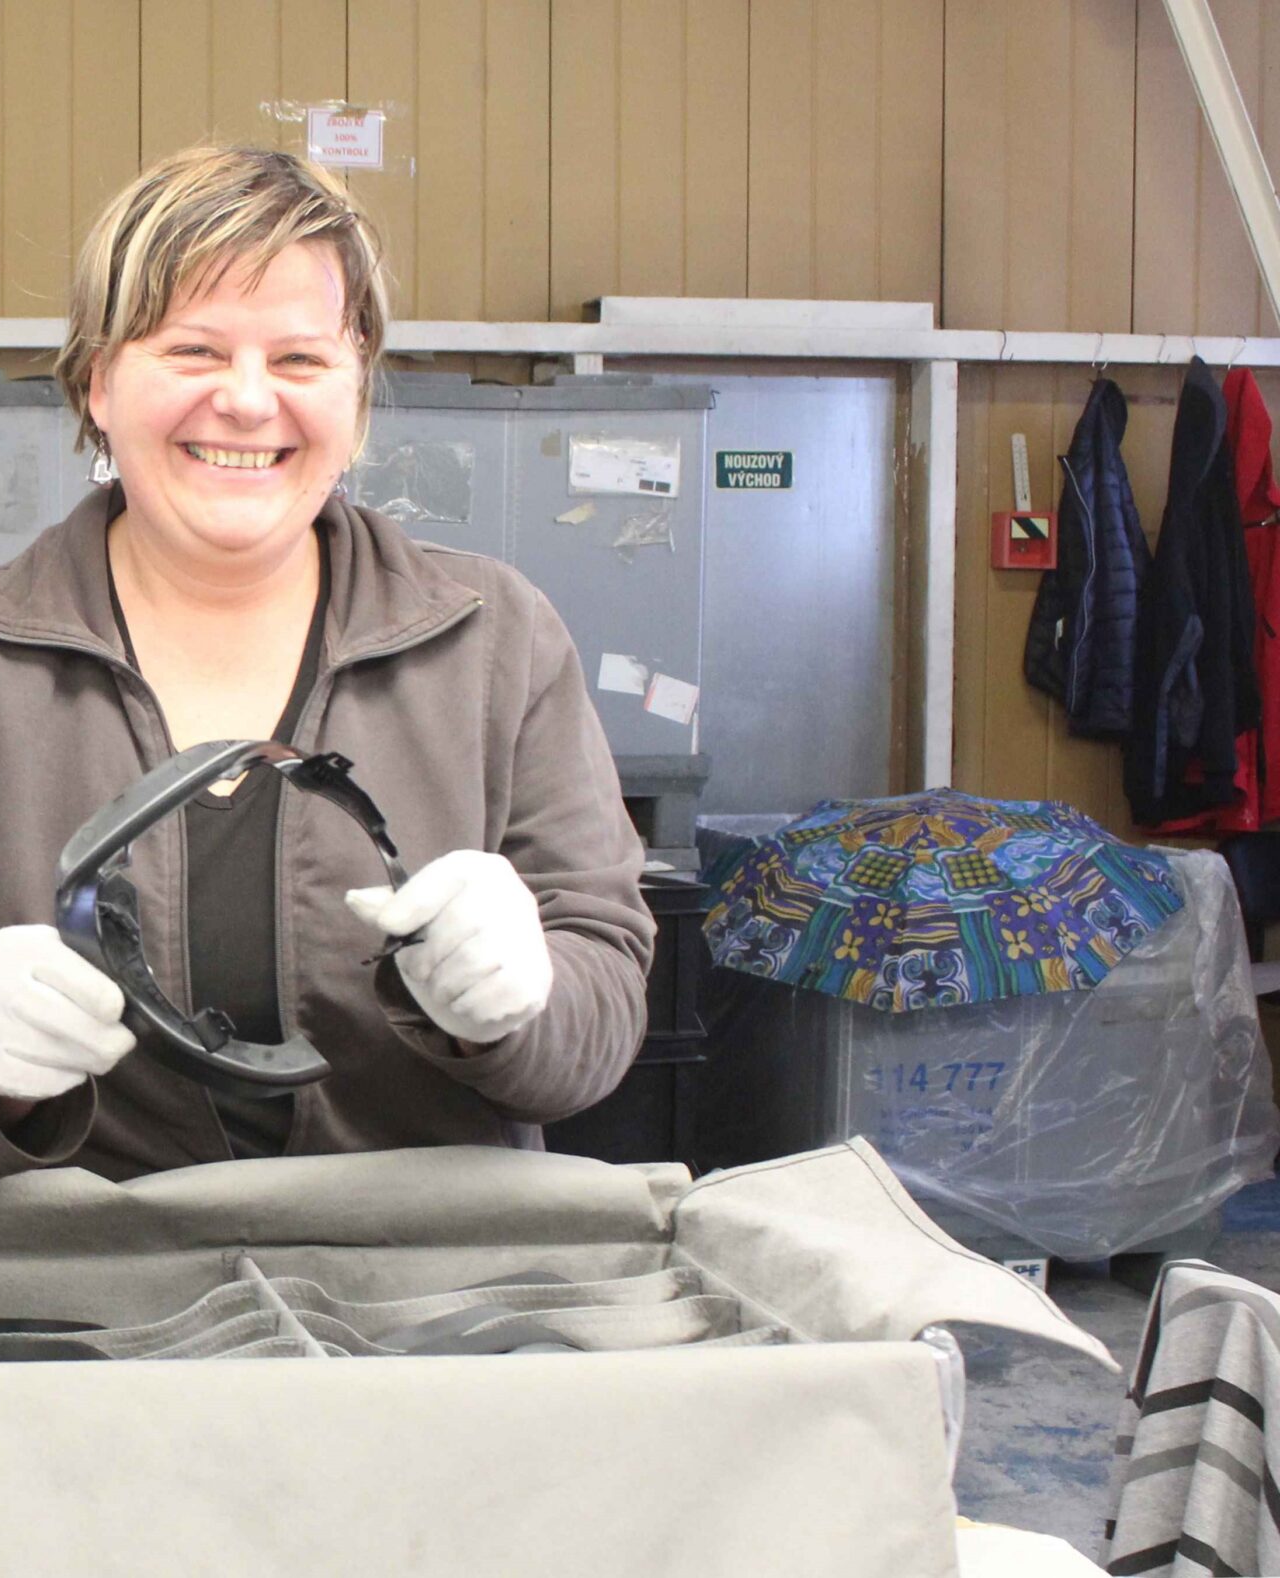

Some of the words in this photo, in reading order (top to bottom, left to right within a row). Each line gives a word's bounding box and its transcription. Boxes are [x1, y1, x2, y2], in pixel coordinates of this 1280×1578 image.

[335, 134, 358, 142] 100%
[322, 147, 369, 156] KONTROLE
[724, 453, 784, 469] NOUZOVÝ
[728, 471, 781, 487] VÝCHOD
[870, 1063, 928, 1093] 114
[943, 1062, 1006, 1091] 777
